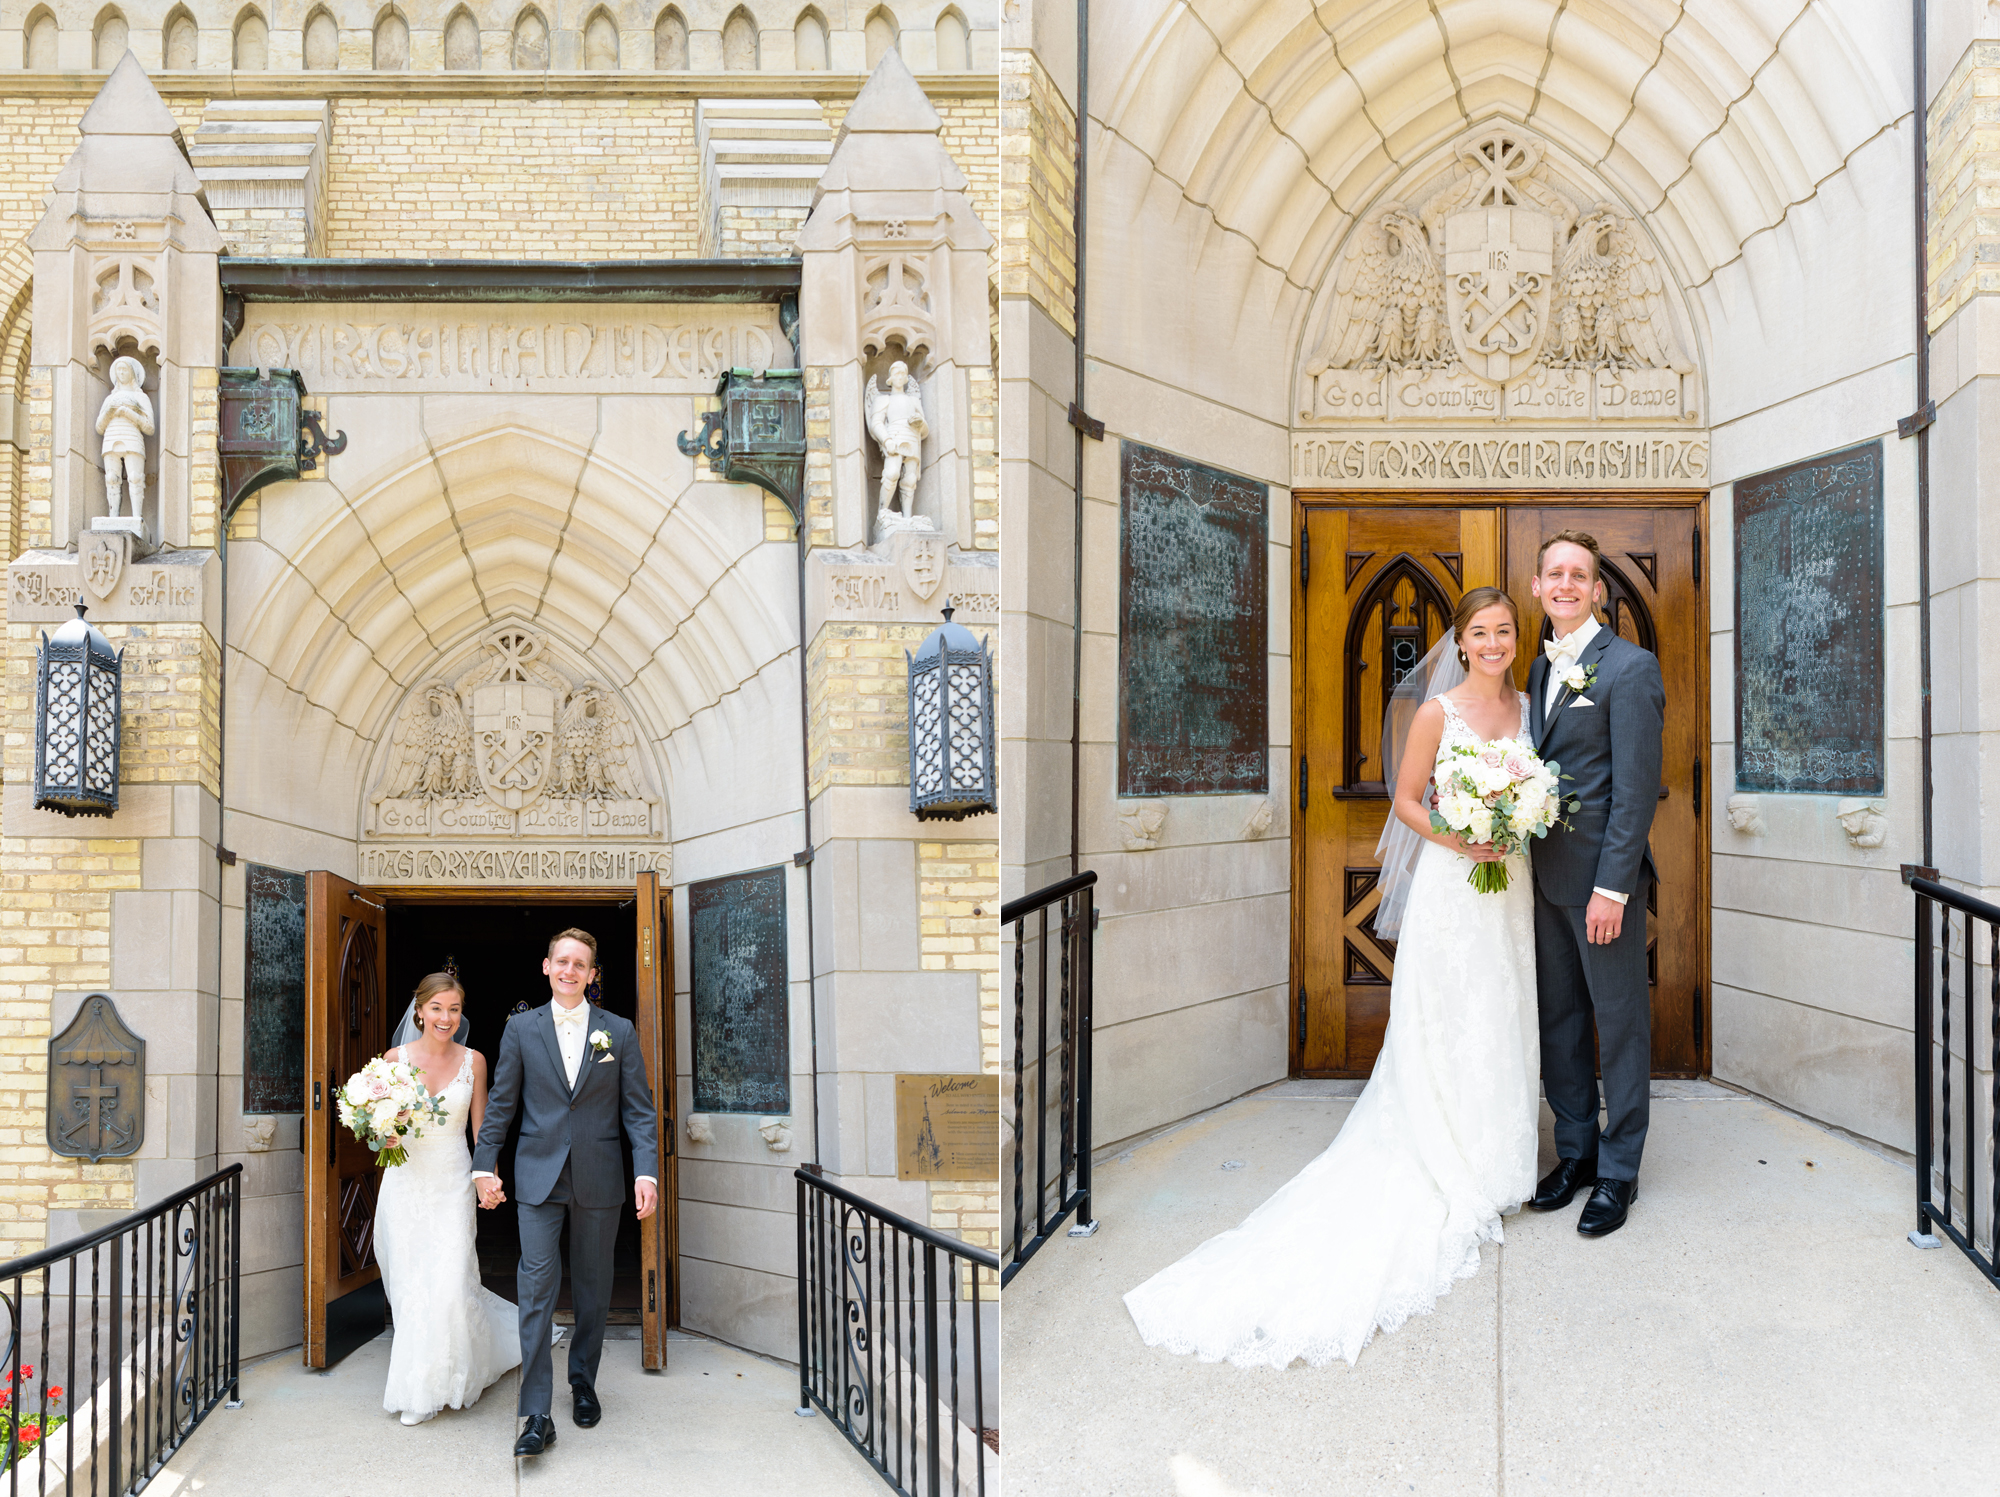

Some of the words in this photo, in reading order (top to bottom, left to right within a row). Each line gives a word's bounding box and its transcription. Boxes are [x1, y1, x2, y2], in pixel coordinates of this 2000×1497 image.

[250, 323, 362, 381] OUR
[630, 323, 774, 381] DEAD
[1323, 380, 1383, 407] God
[1399, 382, 1497, 412] Country
[1512, 382, 1586, 407] Notre
[1600, 382, 1677, 407] Dame
[383, 807, 427, 827] God
[440, 808, 512, 830] Country
[524, 809, 579, 828] Notre
[590, 809, 647, 827] Dame
[928, 1078, 979, 1098] Welcome
